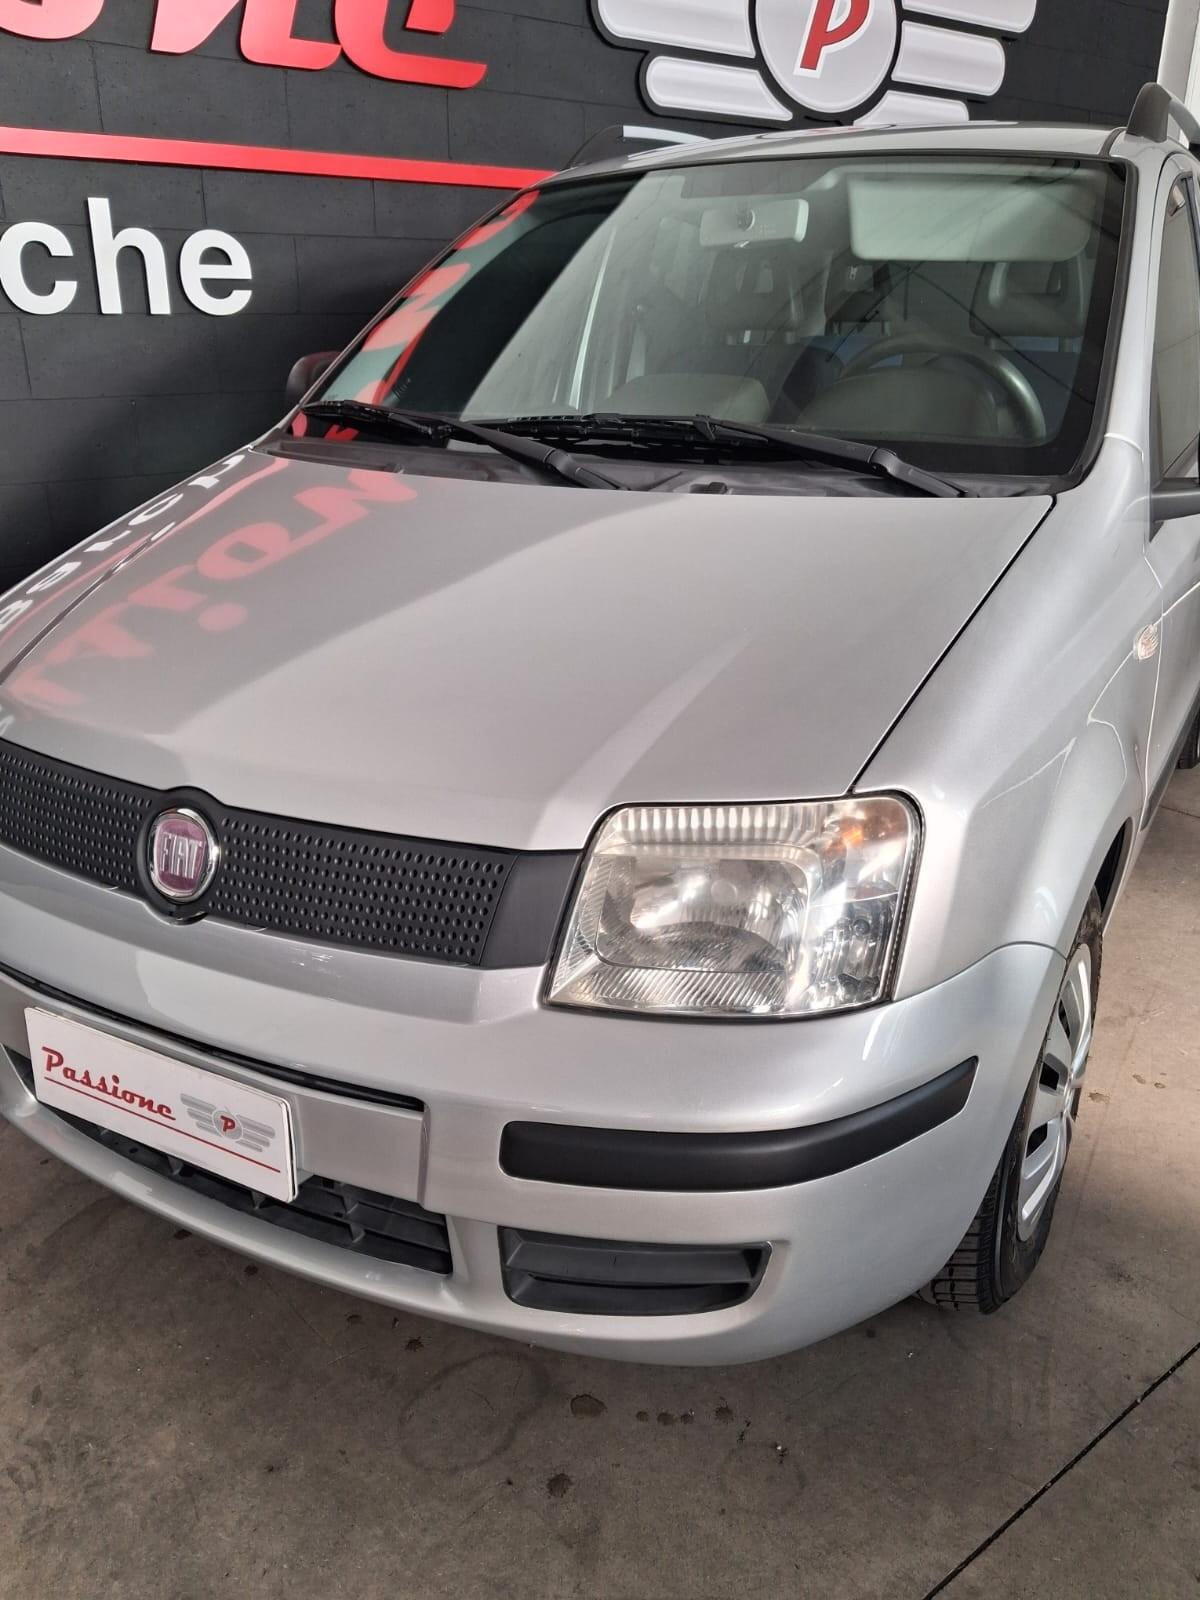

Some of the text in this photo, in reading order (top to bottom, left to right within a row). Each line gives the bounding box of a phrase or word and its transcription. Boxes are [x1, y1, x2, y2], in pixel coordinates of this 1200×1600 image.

[0, 197, 253, 316] che
[160, 831, 203, 880] FIAT
[42, 1046, 176, 1121] Passione
